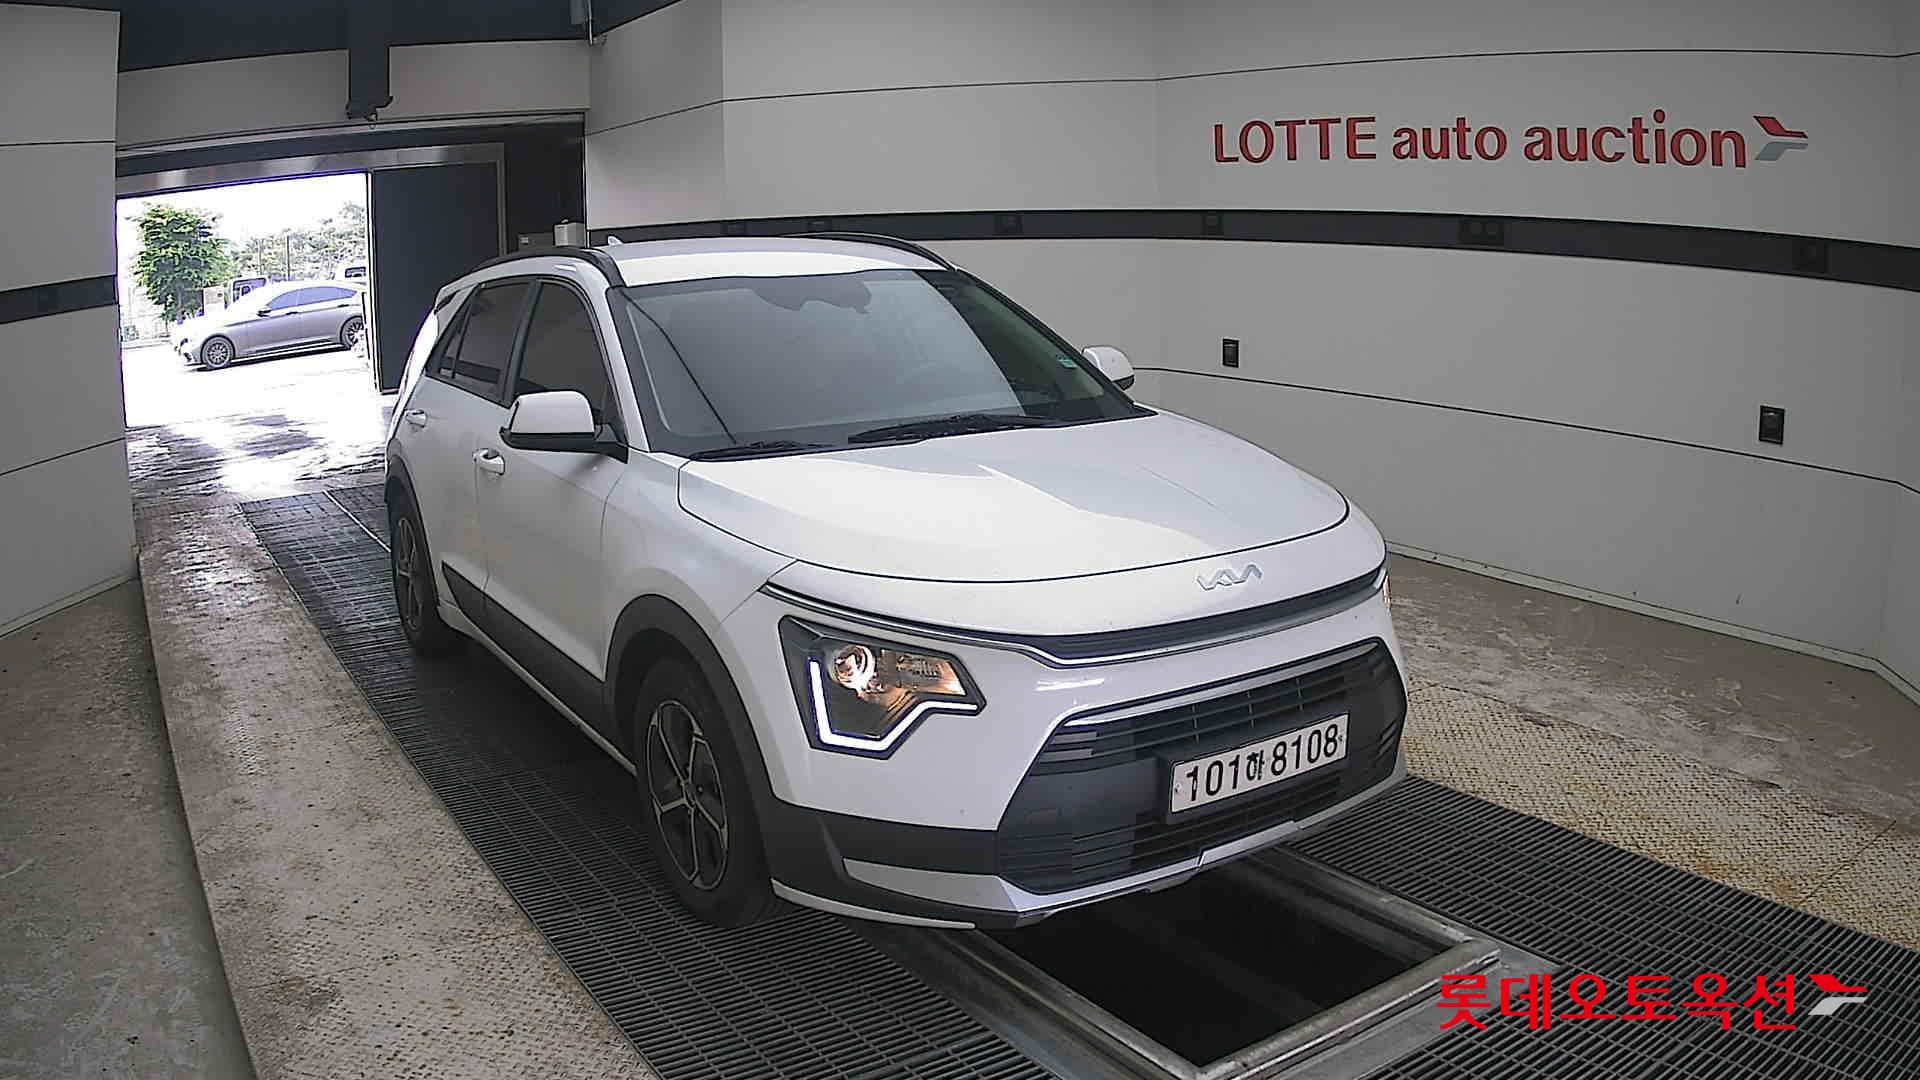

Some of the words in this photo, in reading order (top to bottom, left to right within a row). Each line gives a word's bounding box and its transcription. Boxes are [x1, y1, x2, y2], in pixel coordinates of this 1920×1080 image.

[1214, 117, 1377, 164] LOTTE
[1393, 117, 1508, 160] auto
[1524, 109, 1747, 169] auction
